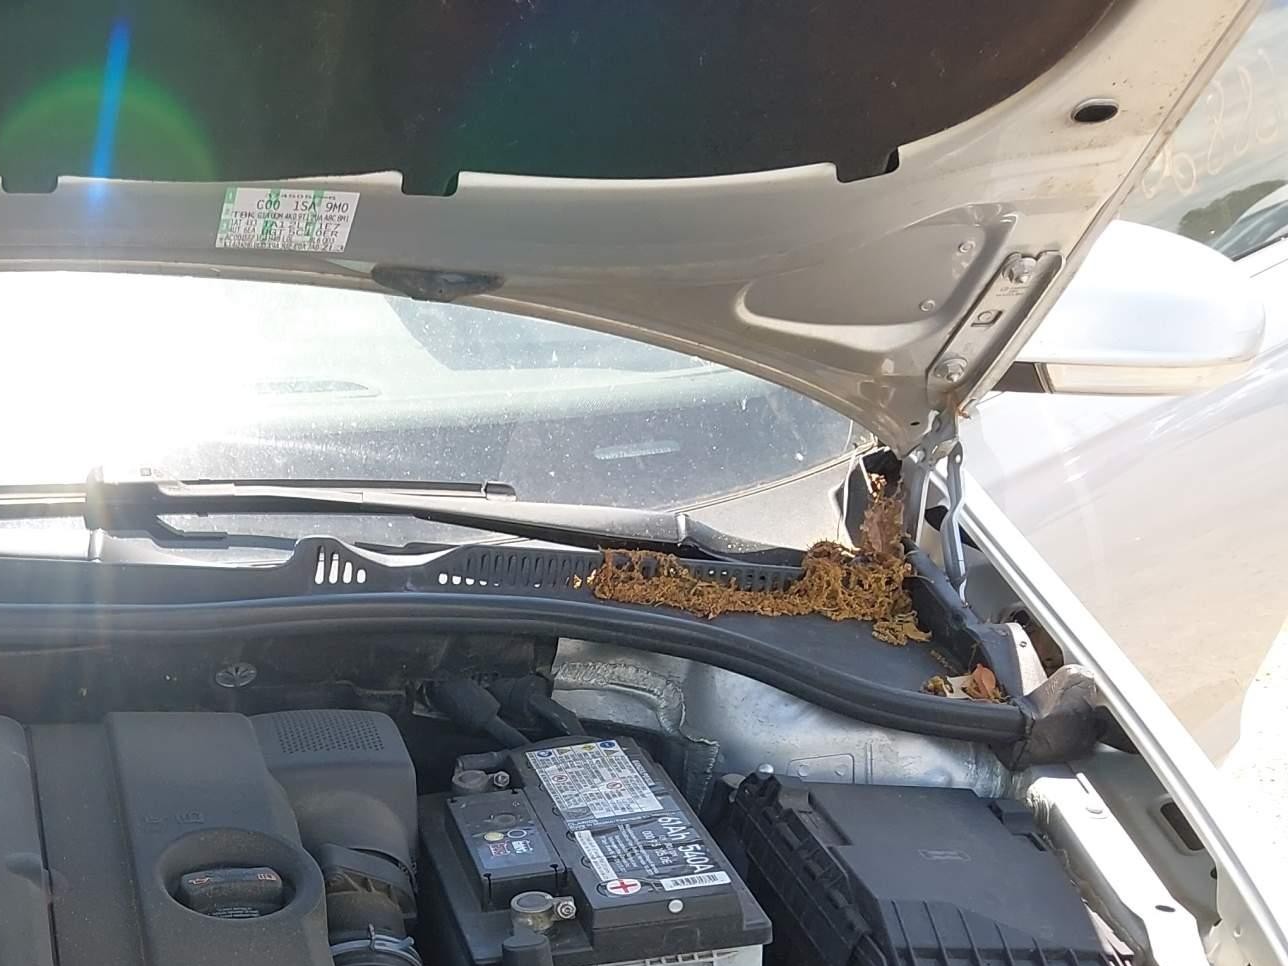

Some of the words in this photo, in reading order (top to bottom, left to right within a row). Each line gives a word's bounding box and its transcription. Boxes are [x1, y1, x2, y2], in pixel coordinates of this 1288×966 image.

[294, 201, 316, 211] 1SA
[657, 816, 690, 841] 61Ah
[678, 843, 714, 873] 540A
